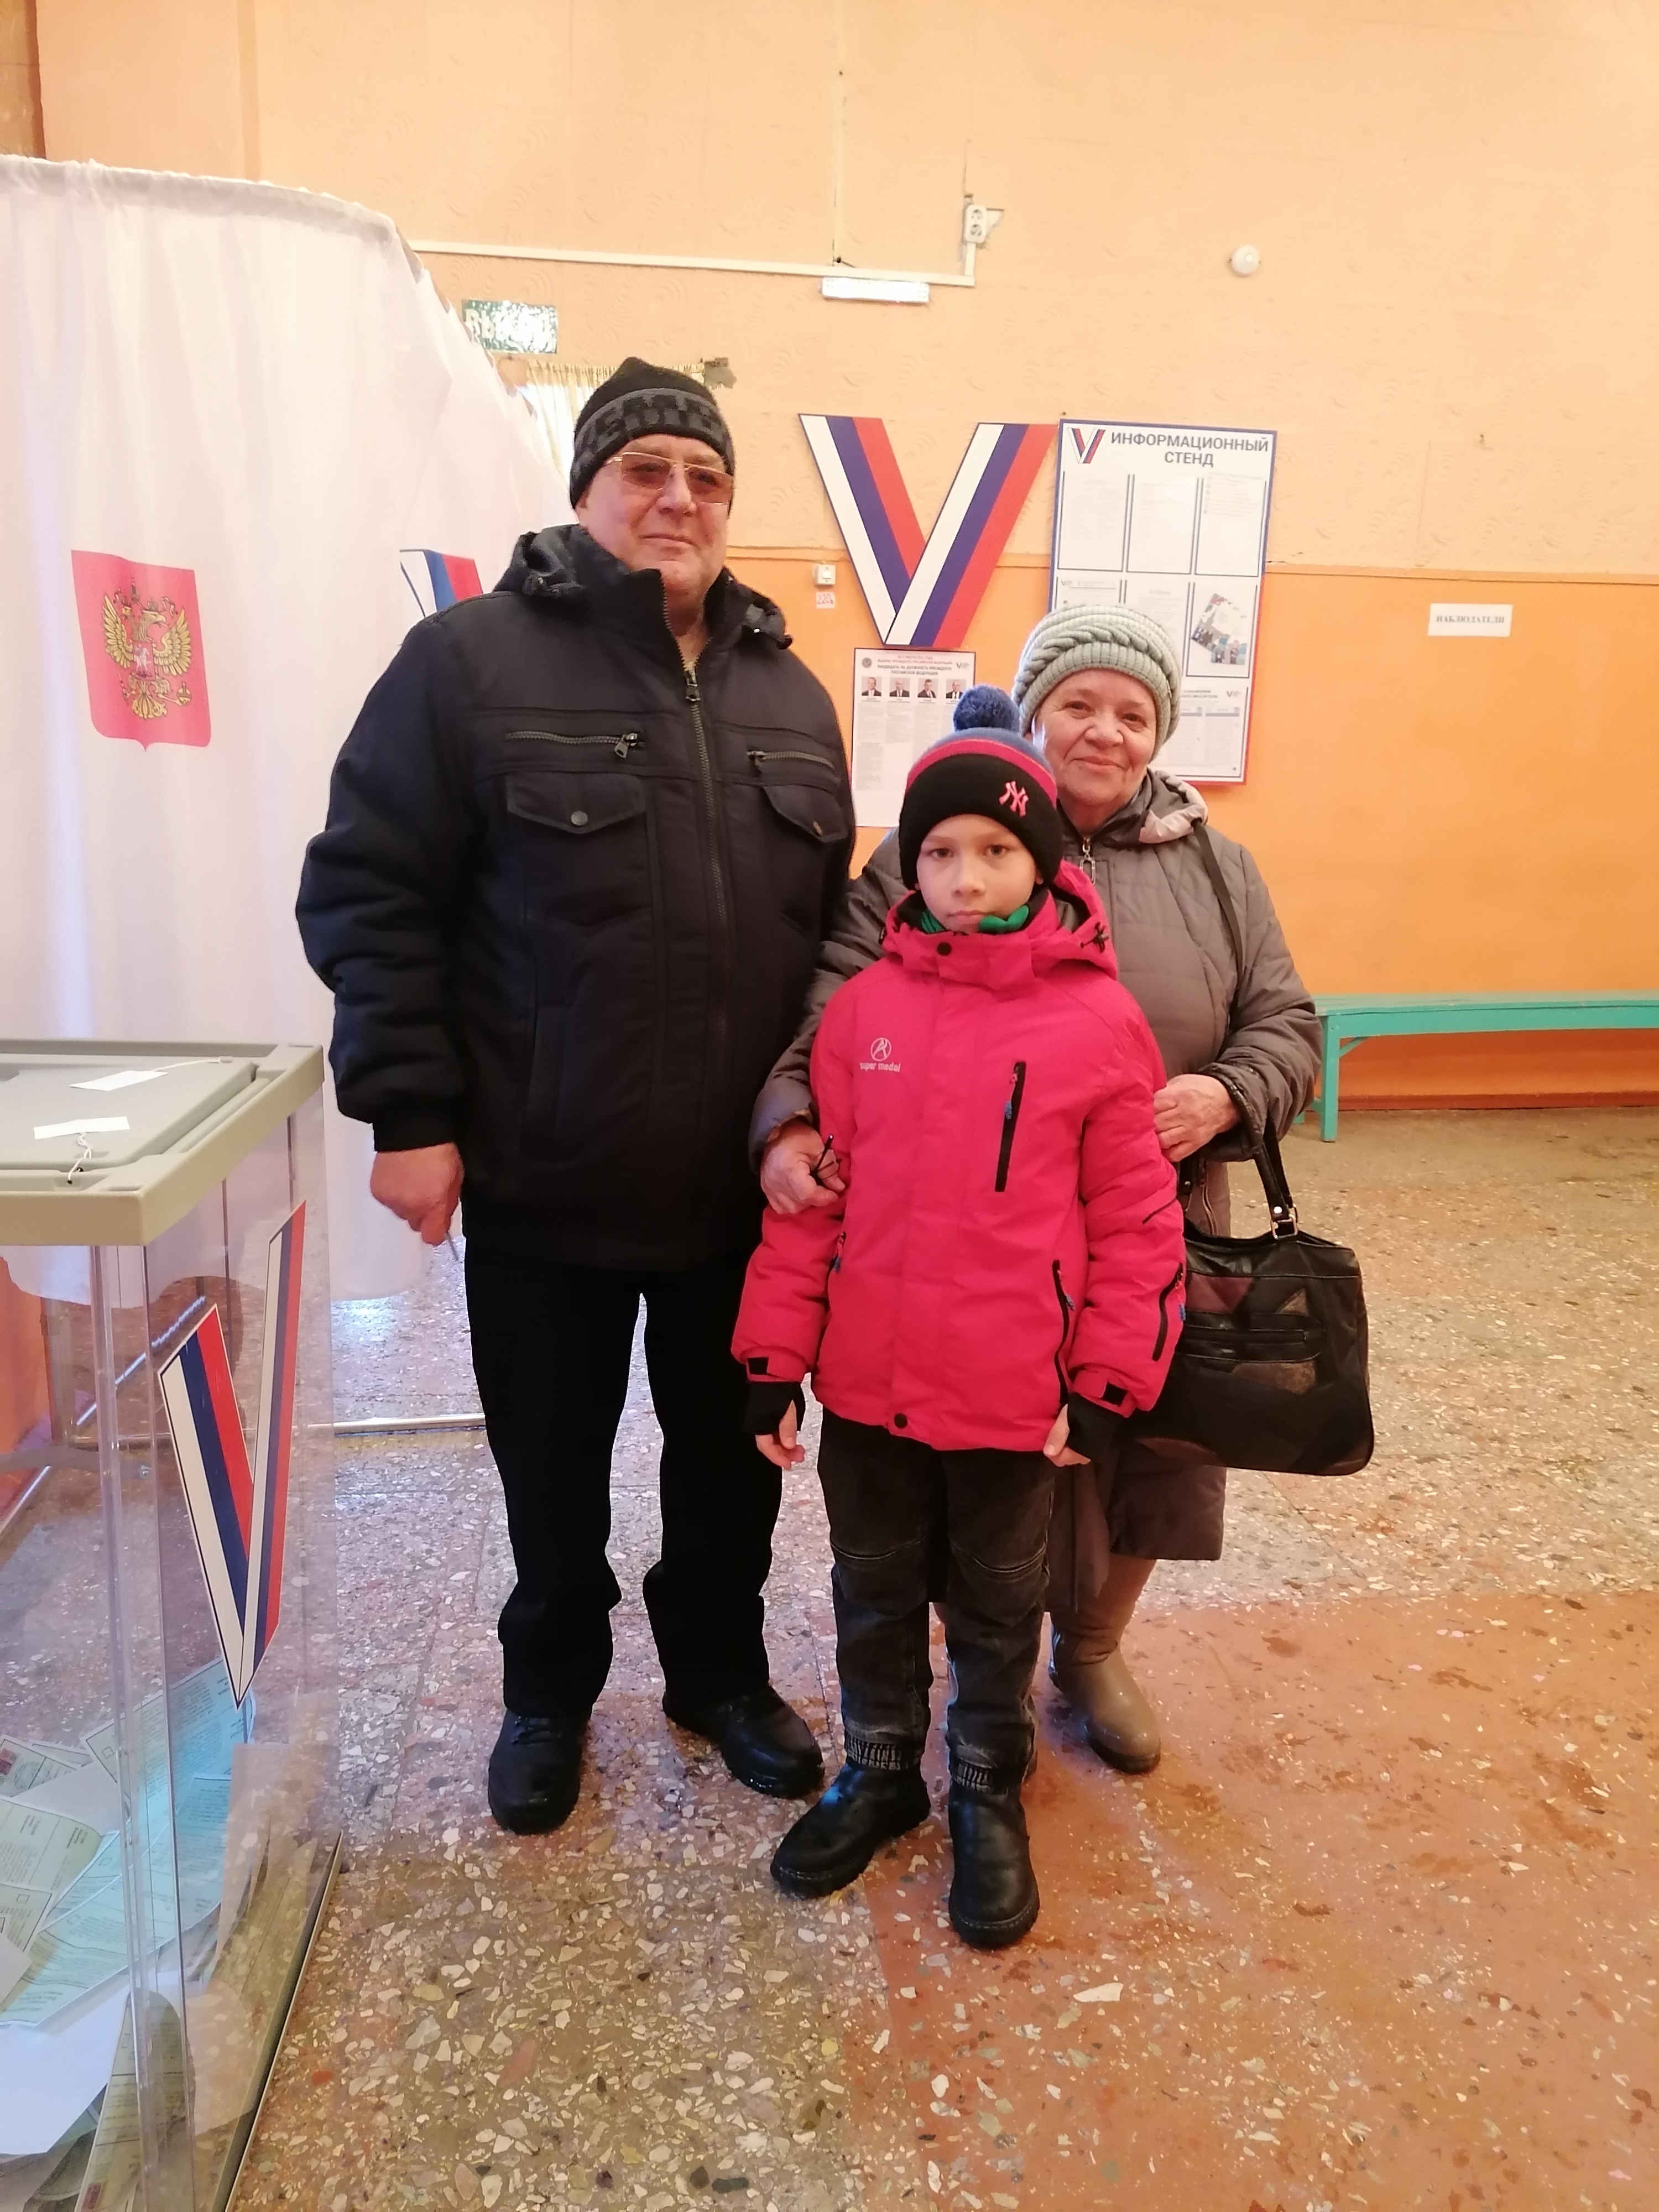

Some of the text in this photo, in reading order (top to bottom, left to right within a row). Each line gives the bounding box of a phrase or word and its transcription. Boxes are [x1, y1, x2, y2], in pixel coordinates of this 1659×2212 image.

[1110, 431, 1269, 452] ИНФОРМАЦИОННЫЙ
[1164, 451, 1214, 468] СТЕНД
[1436, 615, 1505, 624] НАБЛЮДАТЕЛИ
